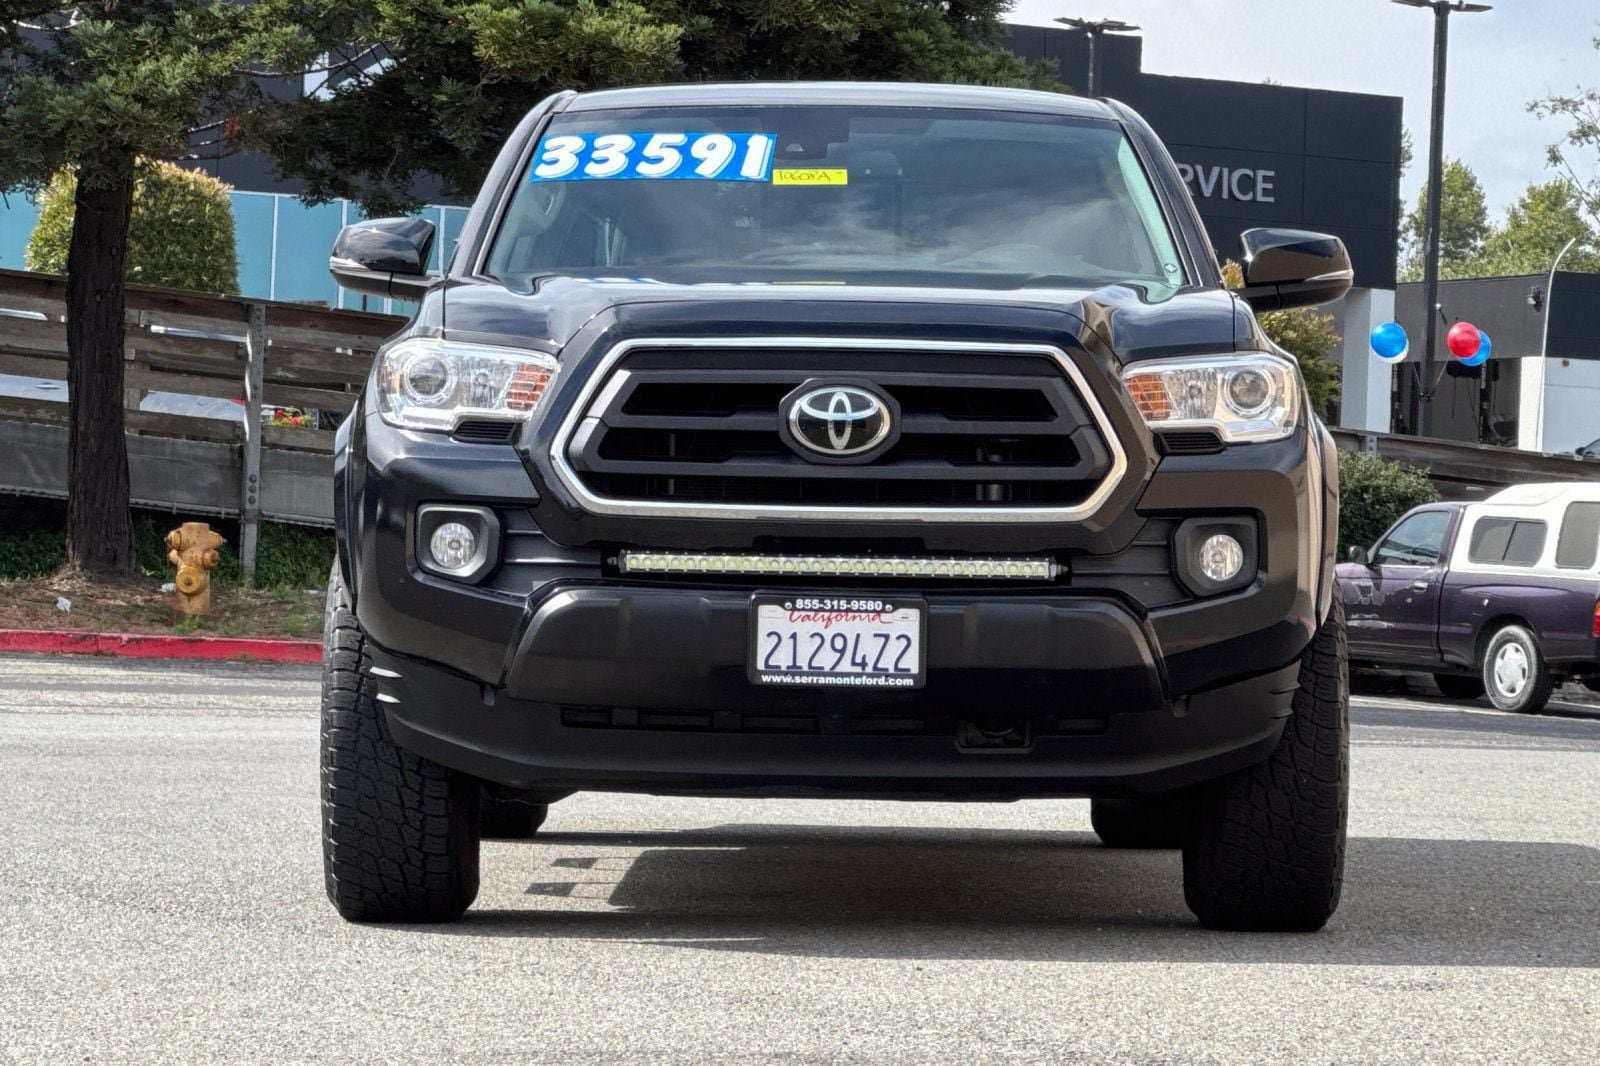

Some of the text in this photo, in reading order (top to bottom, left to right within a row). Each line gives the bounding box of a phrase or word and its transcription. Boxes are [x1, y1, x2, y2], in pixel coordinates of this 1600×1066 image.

[534, 133, 771, 179] 33591
[795, 599, 883, 611] 855-315-9580
[763, 630, 912, 673] 21294Z2
[761, 674, 914, 686] www.serramonteford.com
